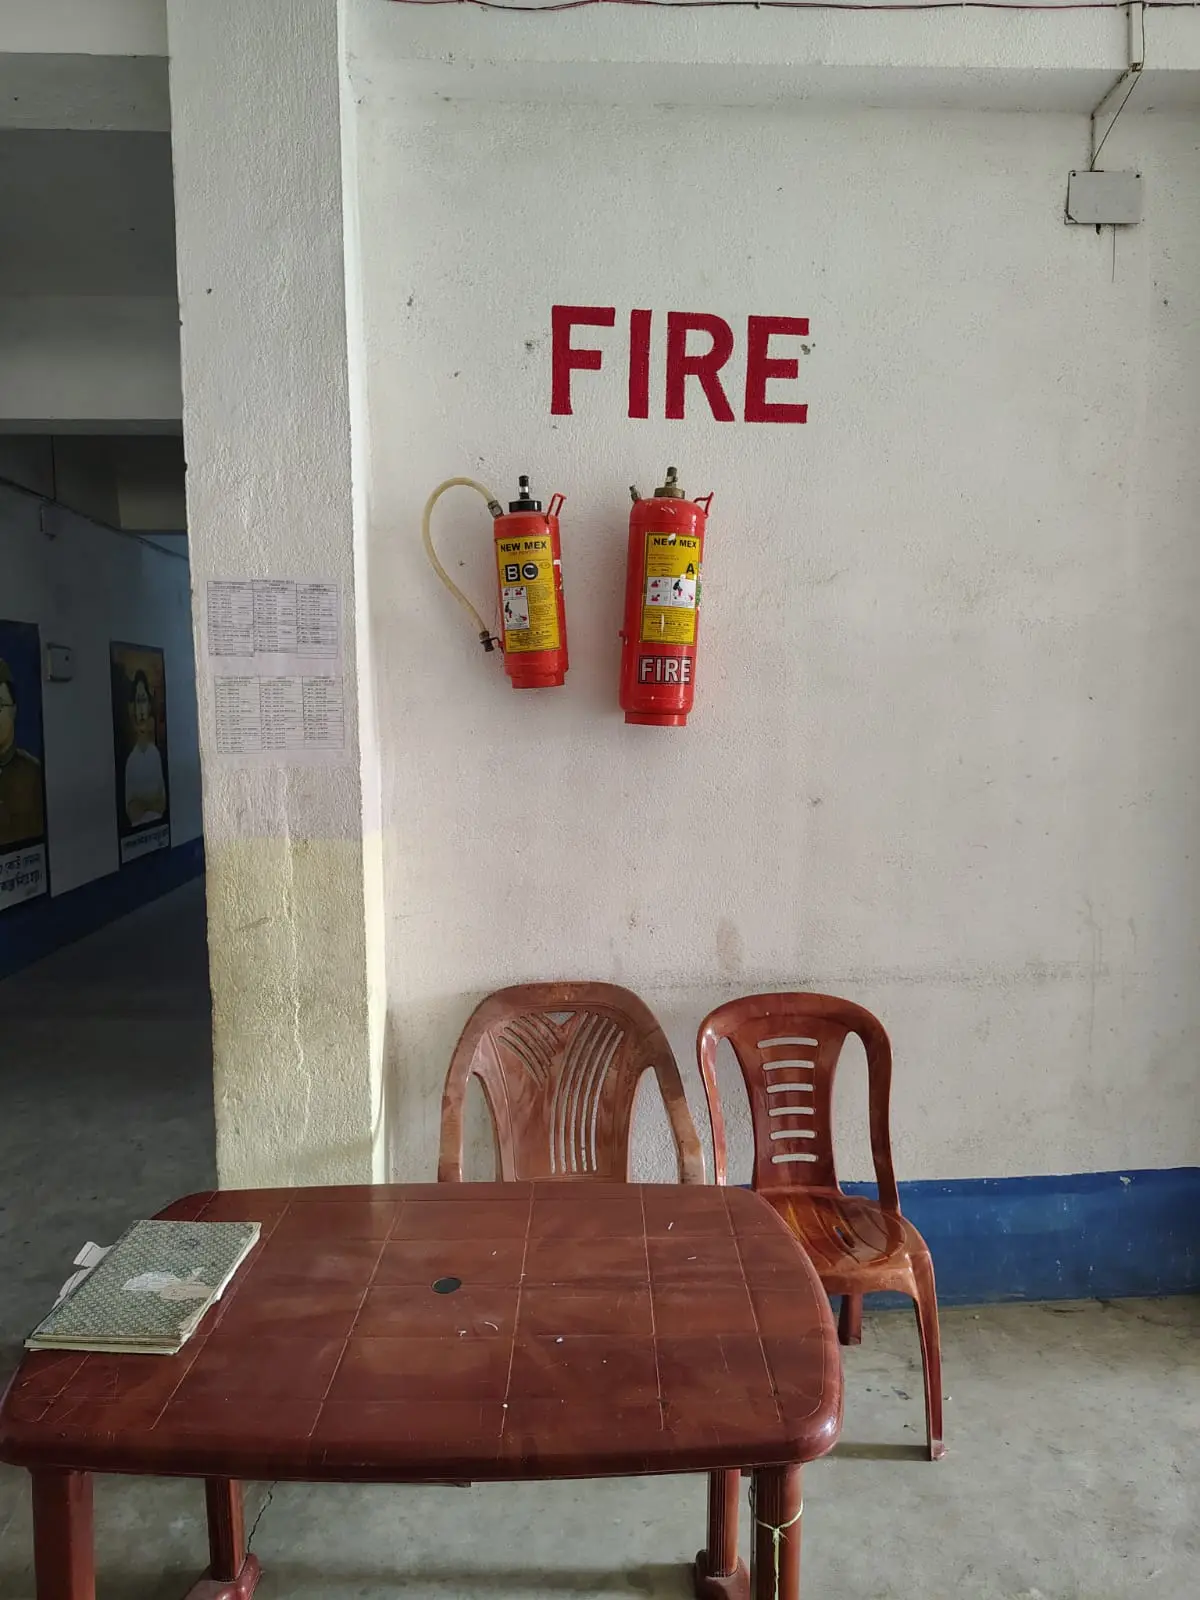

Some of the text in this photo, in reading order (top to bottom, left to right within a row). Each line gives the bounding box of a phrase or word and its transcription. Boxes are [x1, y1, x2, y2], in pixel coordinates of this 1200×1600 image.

[551, 305, 809, 424] FIRE
[500, 541, 547, 552] NEW MEX
[653, 537, 697, 549] NEW MEX
[686, 563, 695, 575] A
[640, 658, 691, 683] FIRE
